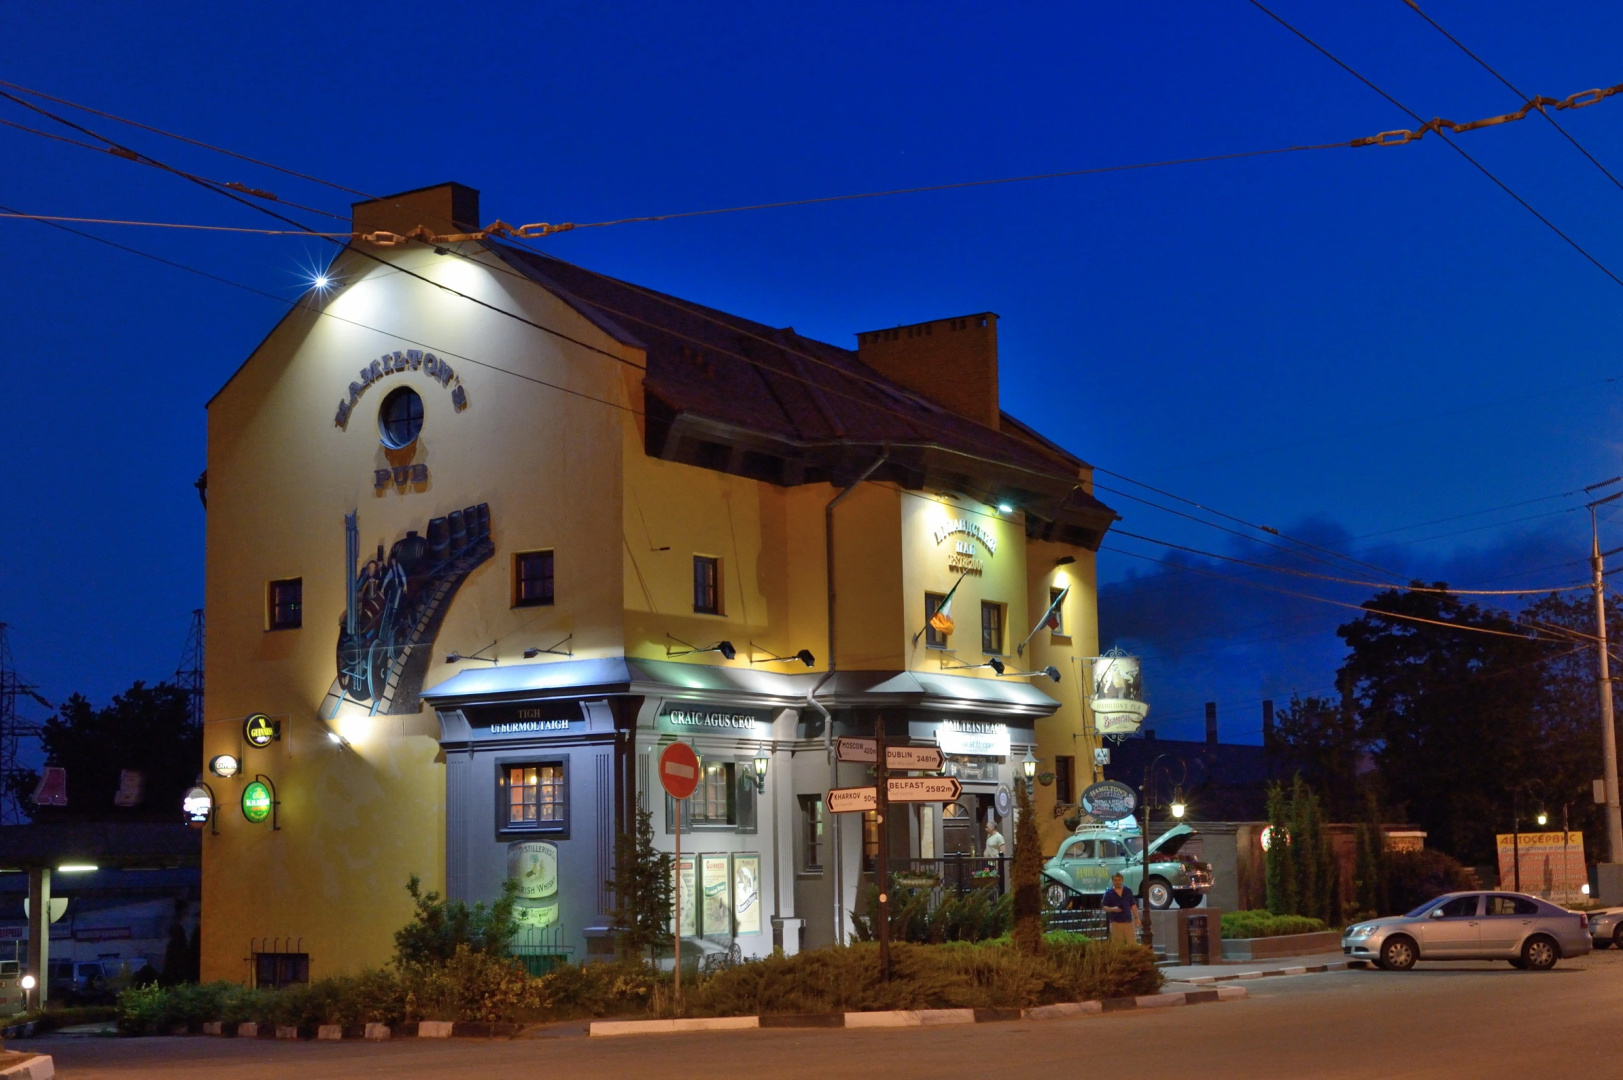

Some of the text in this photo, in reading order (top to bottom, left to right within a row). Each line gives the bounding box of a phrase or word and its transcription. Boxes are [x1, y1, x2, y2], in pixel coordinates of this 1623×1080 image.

[335, 349, 467, 428] HAMILTON'S
[374, 464, 429, 489] PUB
[1096, 702, 1128, 710] HAMILTON'S
[517, 708, 541, 719] TIGH
[670, 710, 756, 729] CRAIC AGUS CEOL
[501, 719, 569, 733] hURMOLTAIGH
[841, 742, 864, 750] MOSCOW
[916, 755, 938, 763] 2481m
[925, 785, 953, 793] 2582m
[1501, 846, 1547, 854] Дианостика
[518, 885, 535, 894] IRISH
[1504, 882, 1581, 892] ШНОМНТАЖ
